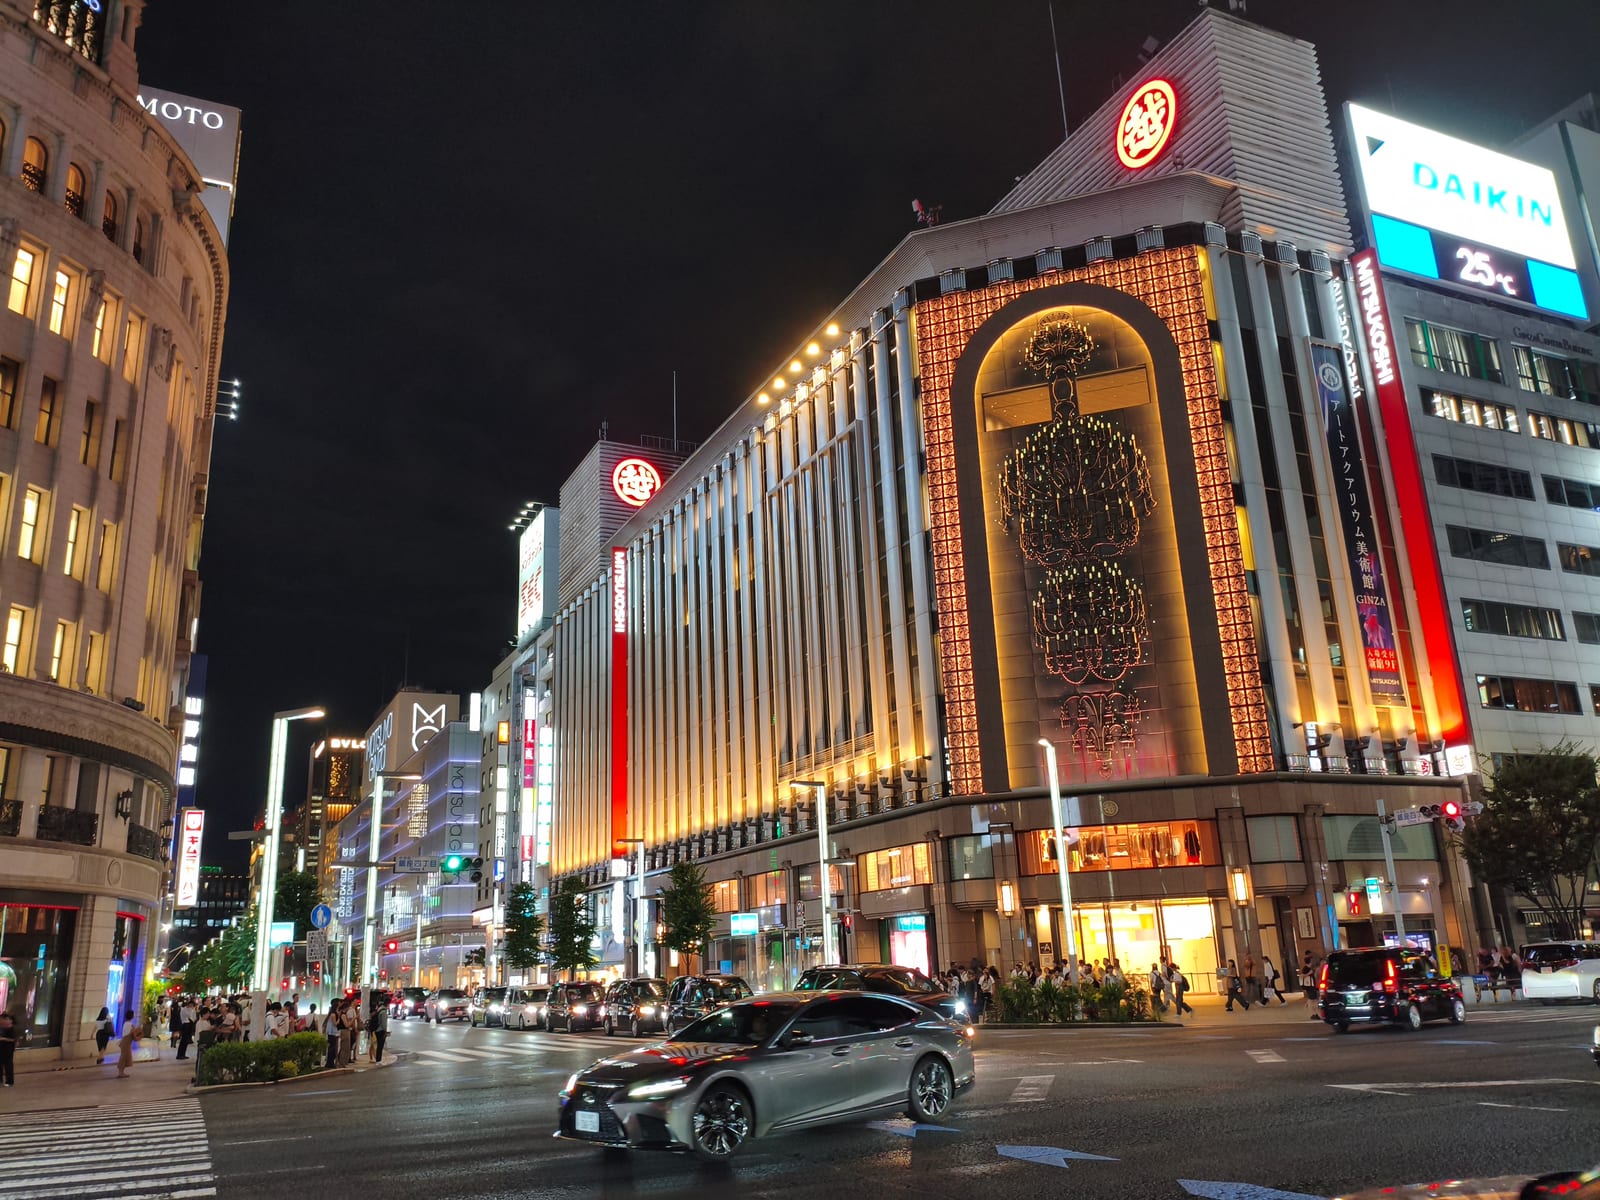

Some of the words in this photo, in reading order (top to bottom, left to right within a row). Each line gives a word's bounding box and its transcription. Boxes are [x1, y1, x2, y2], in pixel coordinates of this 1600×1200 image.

[1412, 161, 1553, 227] DAIKIN
[1356, 256, 1394, 385] MITSUKOSHI
[1331, 399, 1376, 591] アートアクアリウム美術館
[614, 551, 626, 633] MITSUKOSHI
[1356, 594, 1387, 607] GINZA
